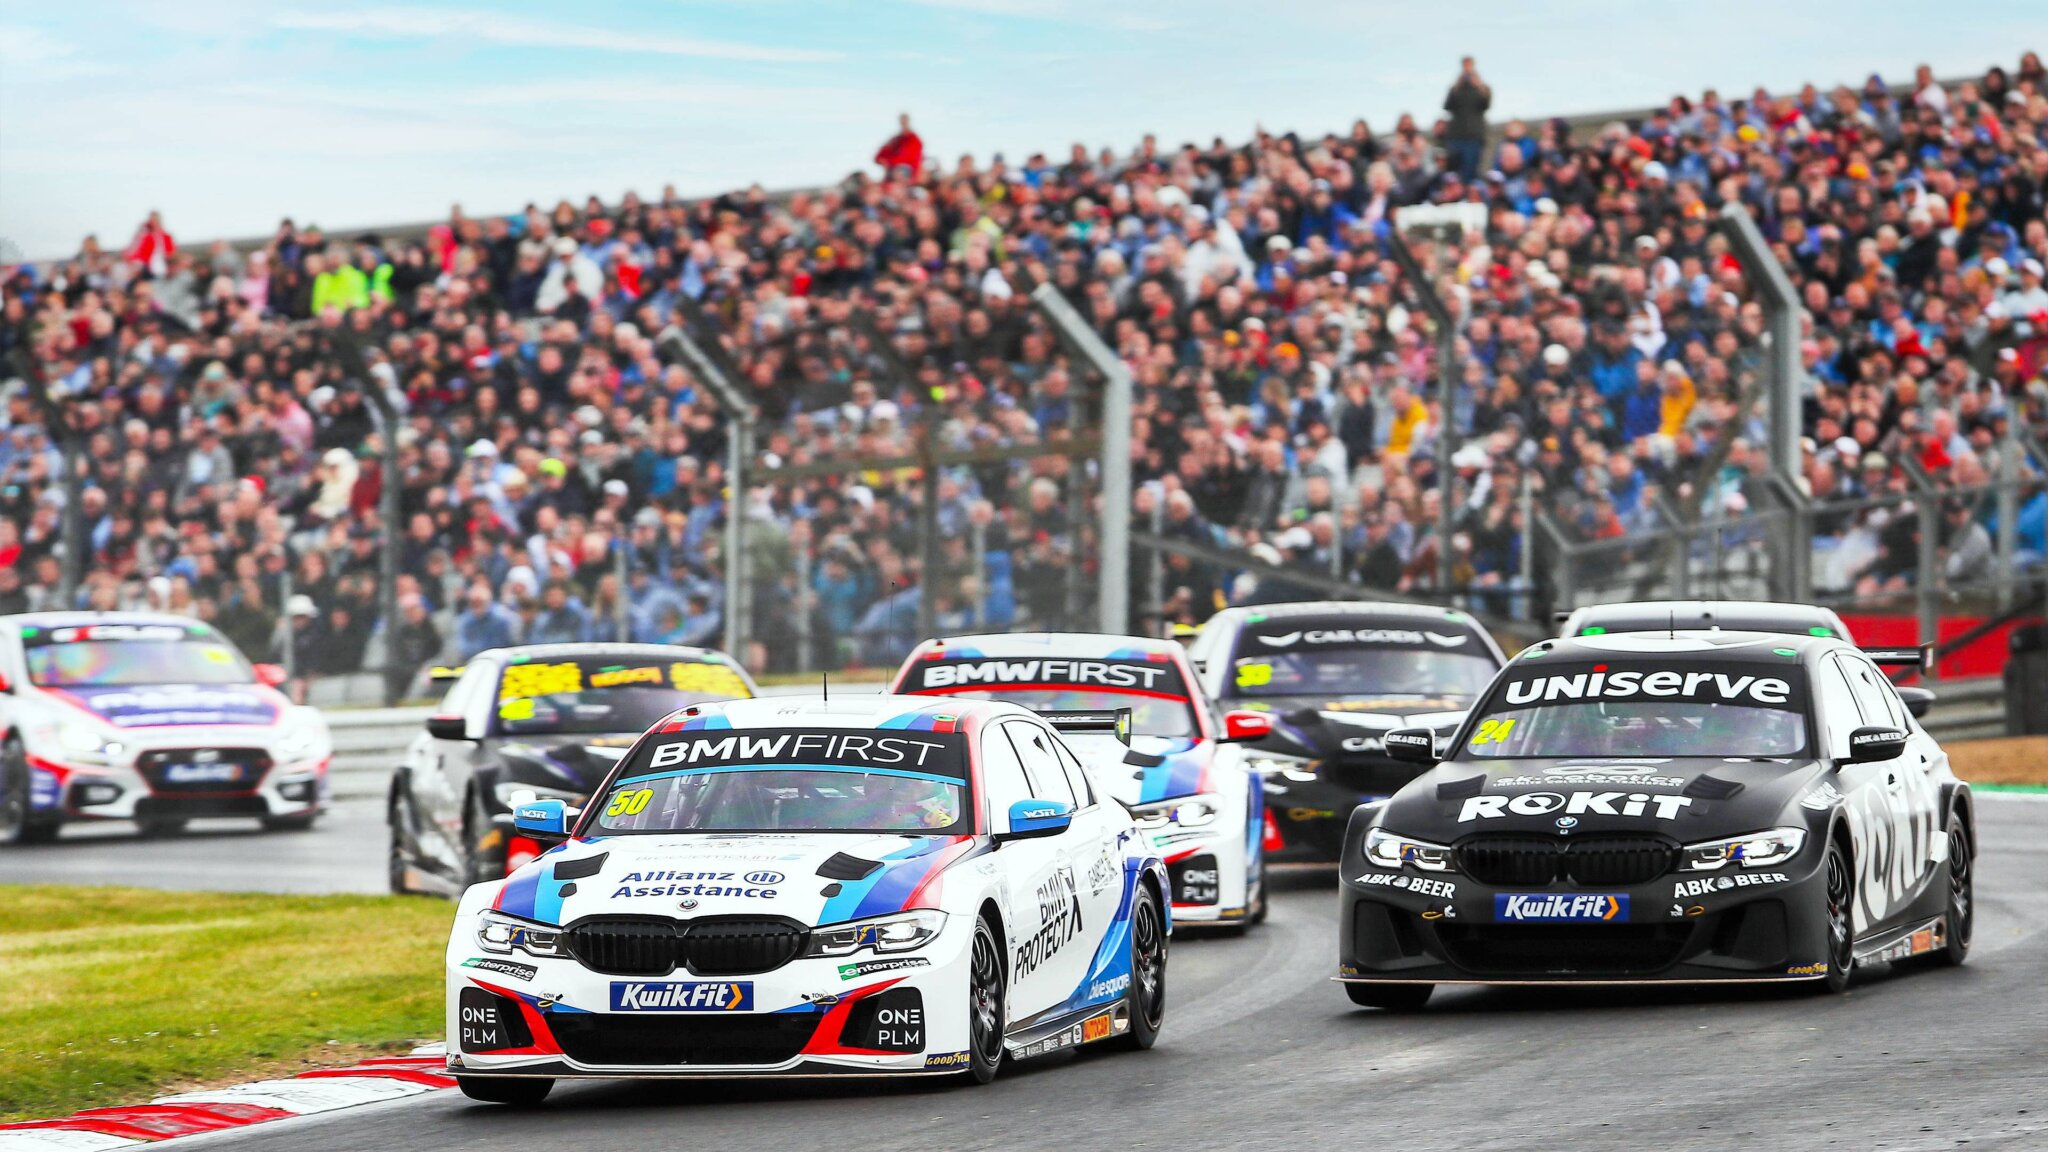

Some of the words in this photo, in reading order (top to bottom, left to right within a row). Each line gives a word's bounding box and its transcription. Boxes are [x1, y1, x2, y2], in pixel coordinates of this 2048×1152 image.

[1471, 719, 1516, 745] 24
[607, 789, 654, 816] 50
[521, 809, 548, 819] WSR
[1022, 808, 1057, 818] WSR
[619, 871, 735, 883] Allianz
[1183, 869, 1217, 884] ONE
[610, 884, 778, 899] Assistance
[1182, 886, 1217, 900] PLM
[1355, 873, 1397, 886] ABK
[1408, 877, 1456, 899] BEER
[1674, 876, 1717, 899] ABK
[1734, 872, 1790, 887] BEER
[1036, 871, 1067, 926] BMW
[1014, 909, 1068, 985] PROTECT
[463, 959, 535, 978] enterprise
[843, 959, 929, 976] enterprise
[462, 1007, 496, 1023] ONE
[878, 1009, 920, 1025] ONE
[463, 1028, 496, 1044] PLM
[878, 1030, 919, 1046] PLM
